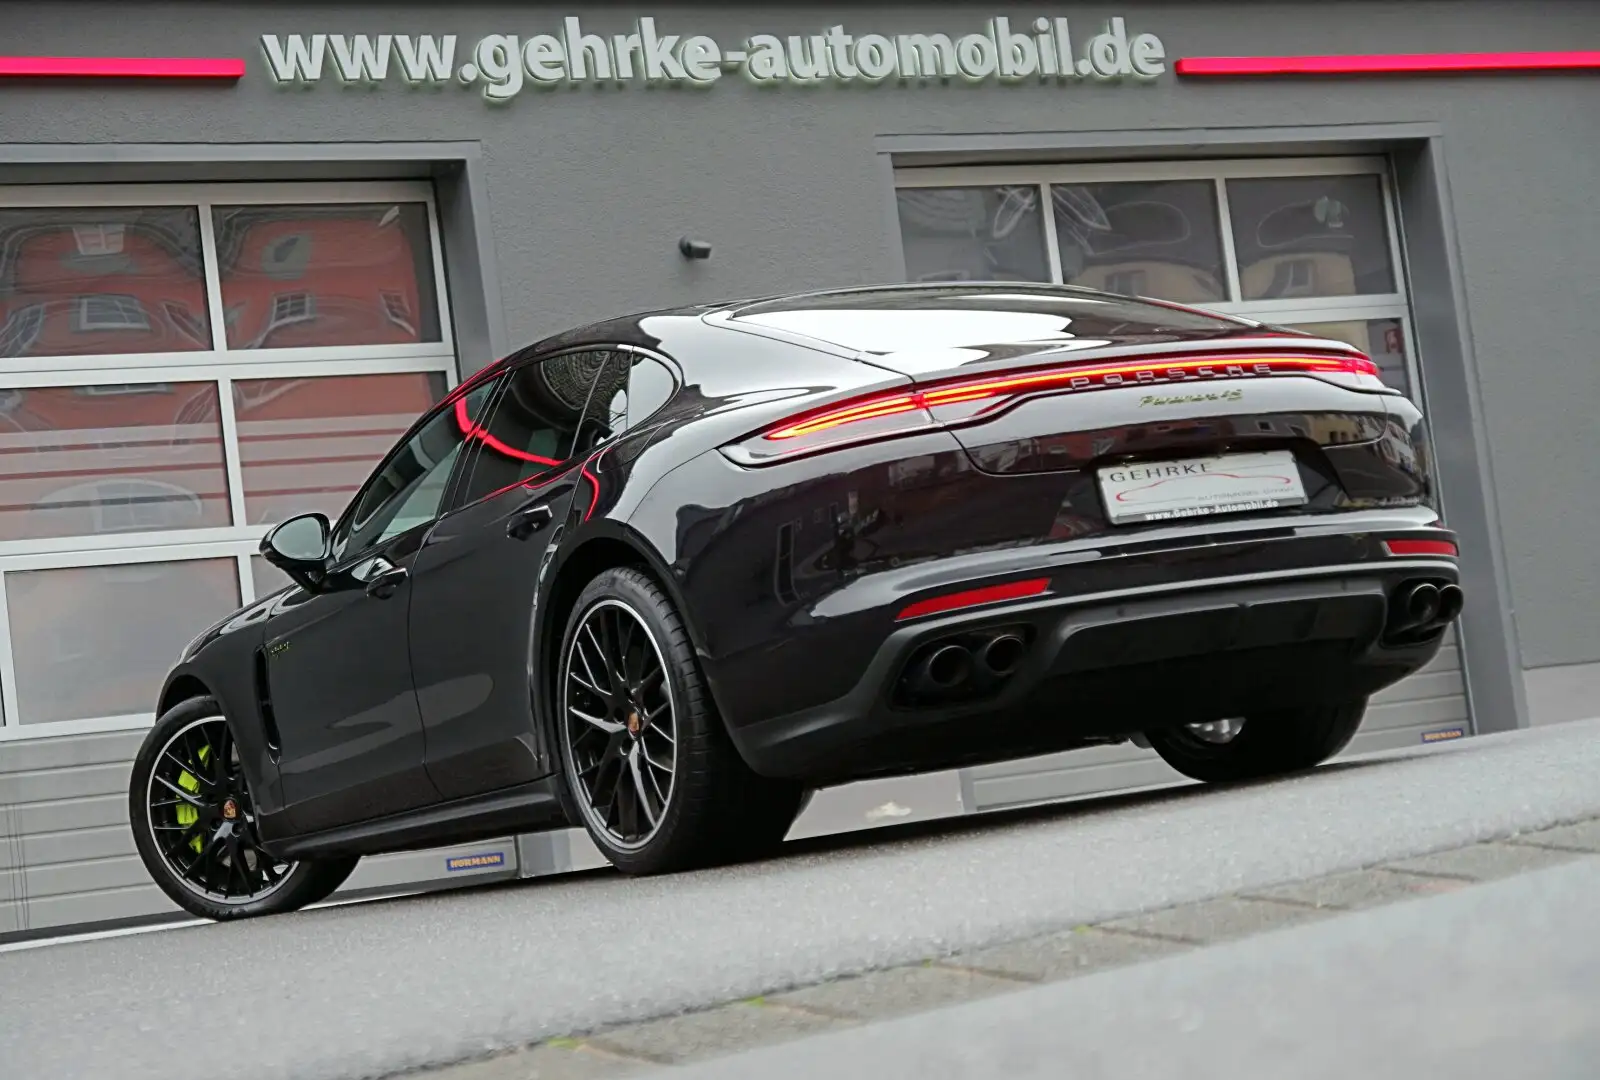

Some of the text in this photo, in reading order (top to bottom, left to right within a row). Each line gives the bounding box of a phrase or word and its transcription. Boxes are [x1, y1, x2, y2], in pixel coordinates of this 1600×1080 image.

[261, 16, 1166, 101] www.gehrke-automobil.de
[1070, 364, 1272, 390] PORSCHE
[1110, 462, 1214, 483] GEHRKE
